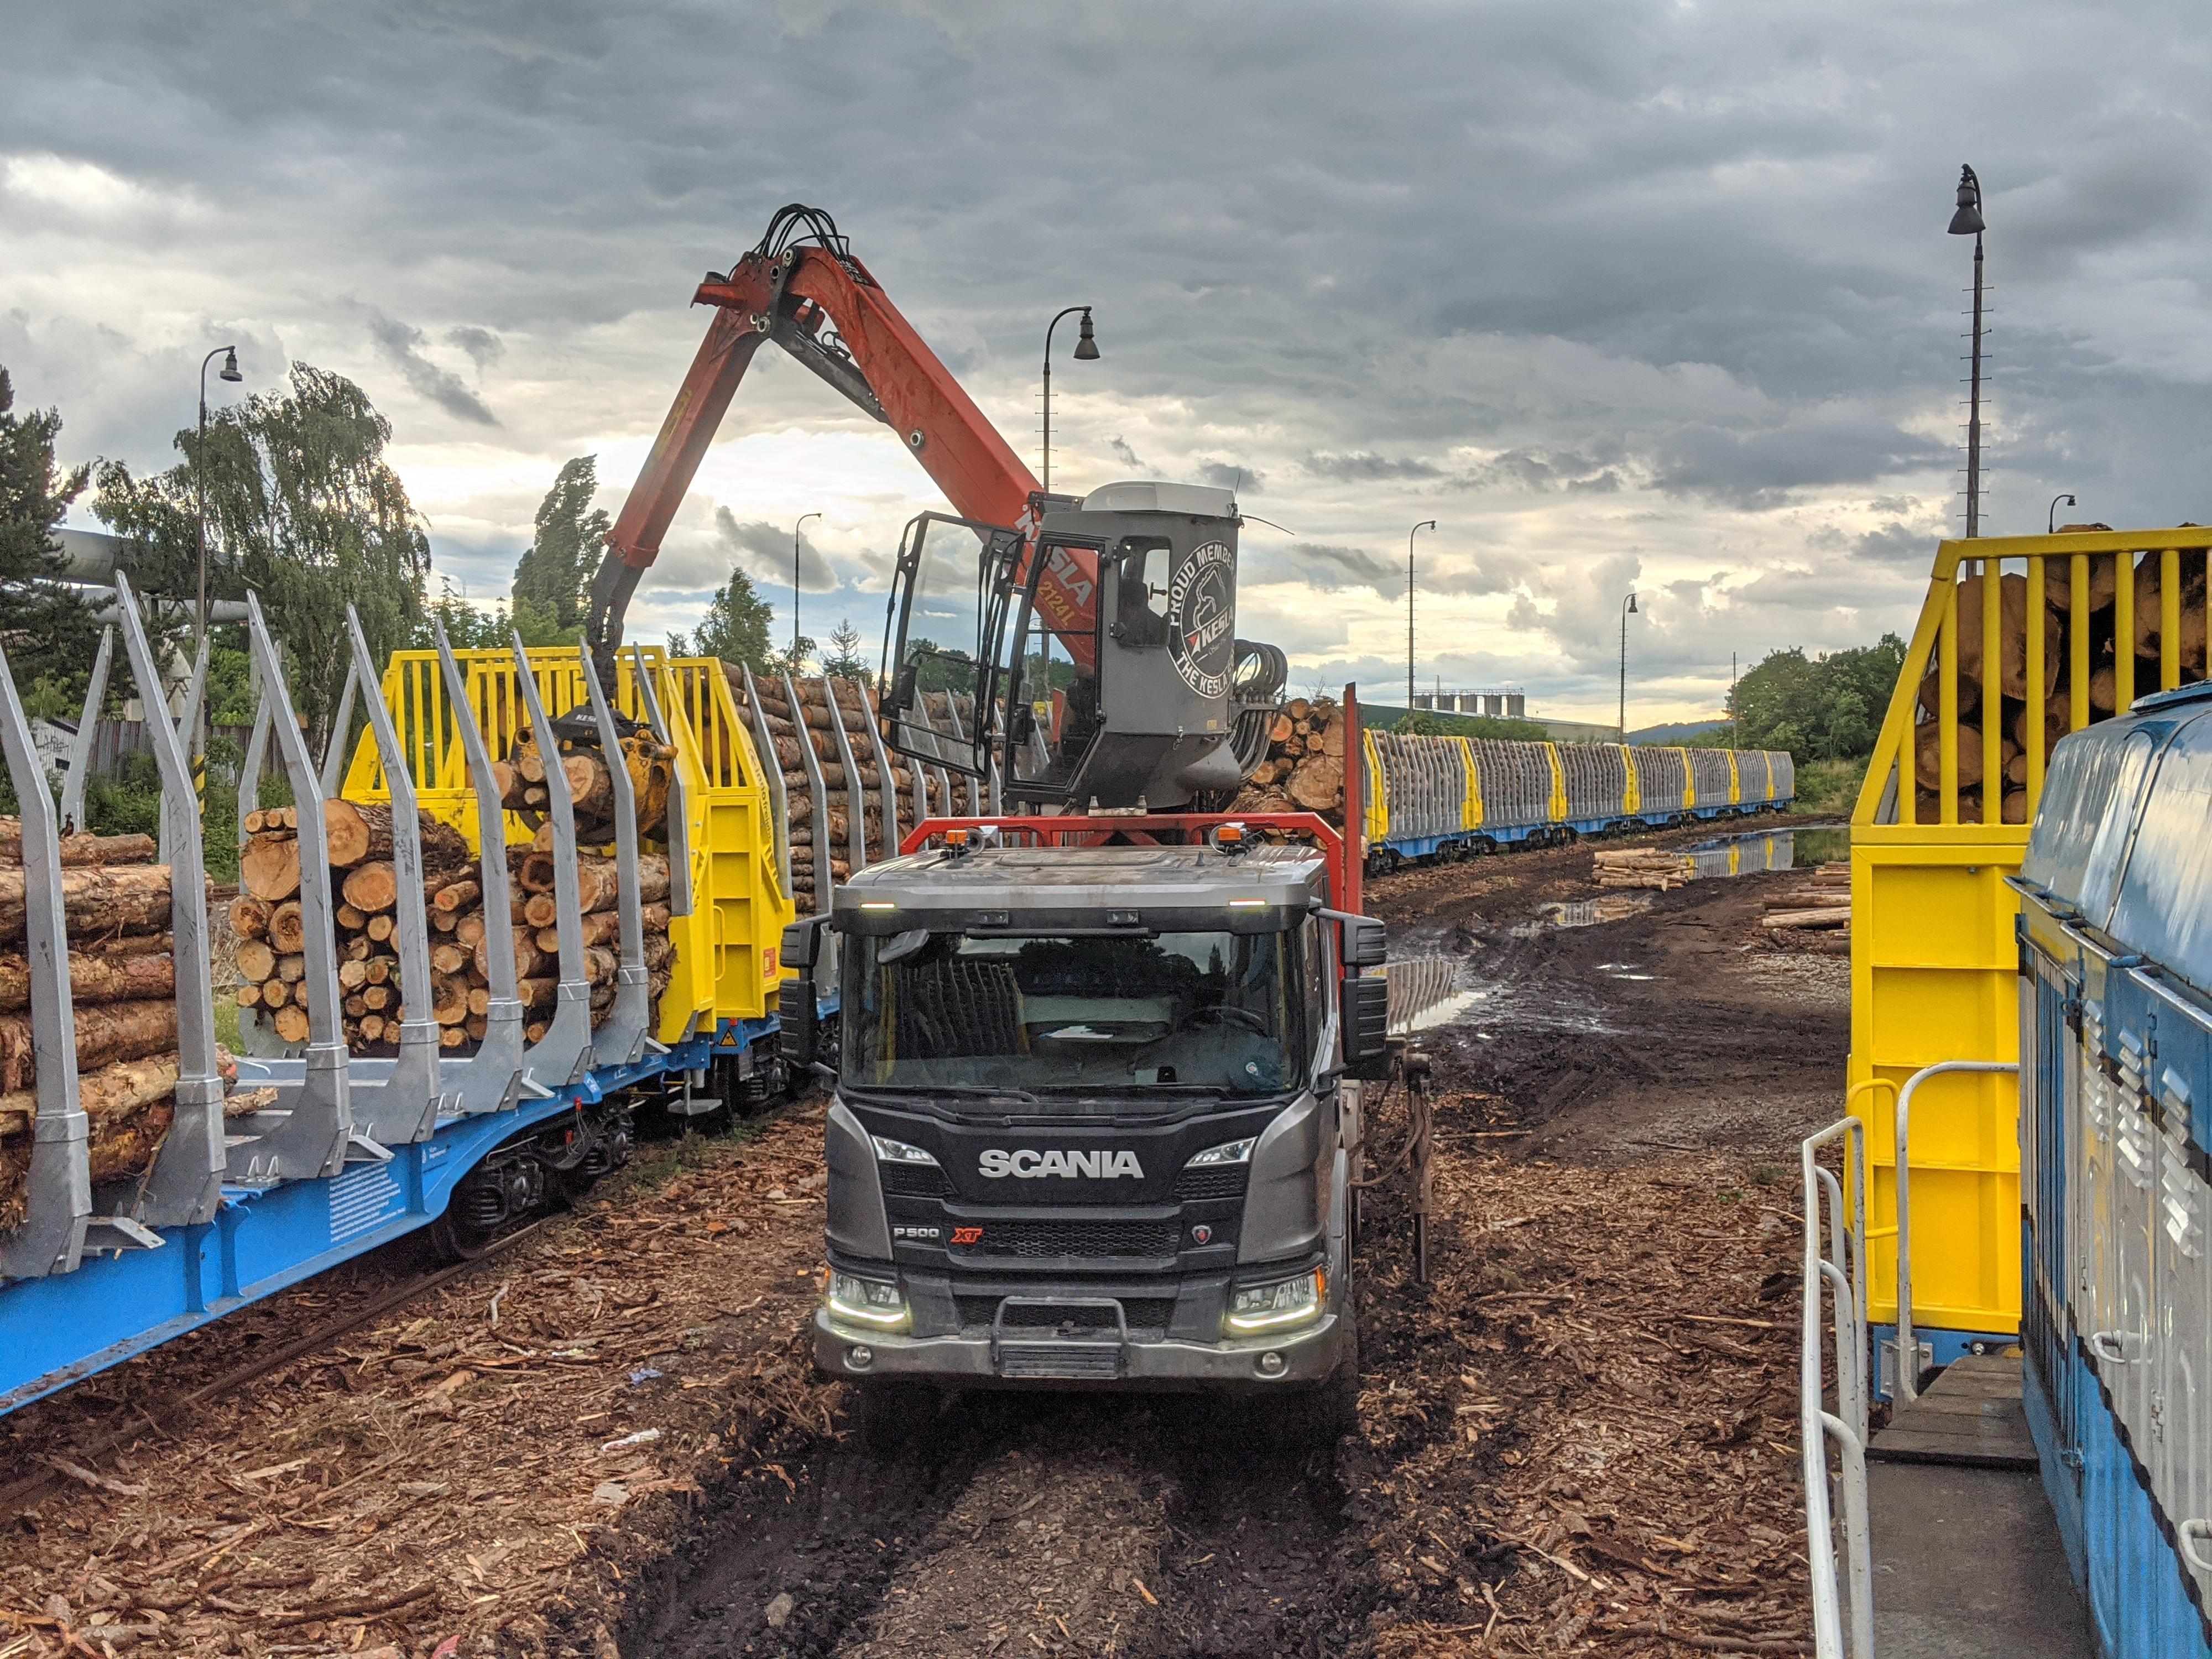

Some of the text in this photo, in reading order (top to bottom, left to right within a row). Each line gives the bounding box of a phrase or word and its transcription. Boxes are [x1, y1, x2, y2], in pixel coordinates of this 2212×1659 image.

[1014, 509, 1093, 607] KSLA
[1170, 544, 1235, 627] PROUD MEMBER
[1202, 604, 1234, 648] KESLA
[1176, 650, 1199, 686] THE
[1199, 673, 1228, 694] KESLA
[978, 1150, 1145, 1178] SCANIA
[950, 1227, 984, 1243] XT
